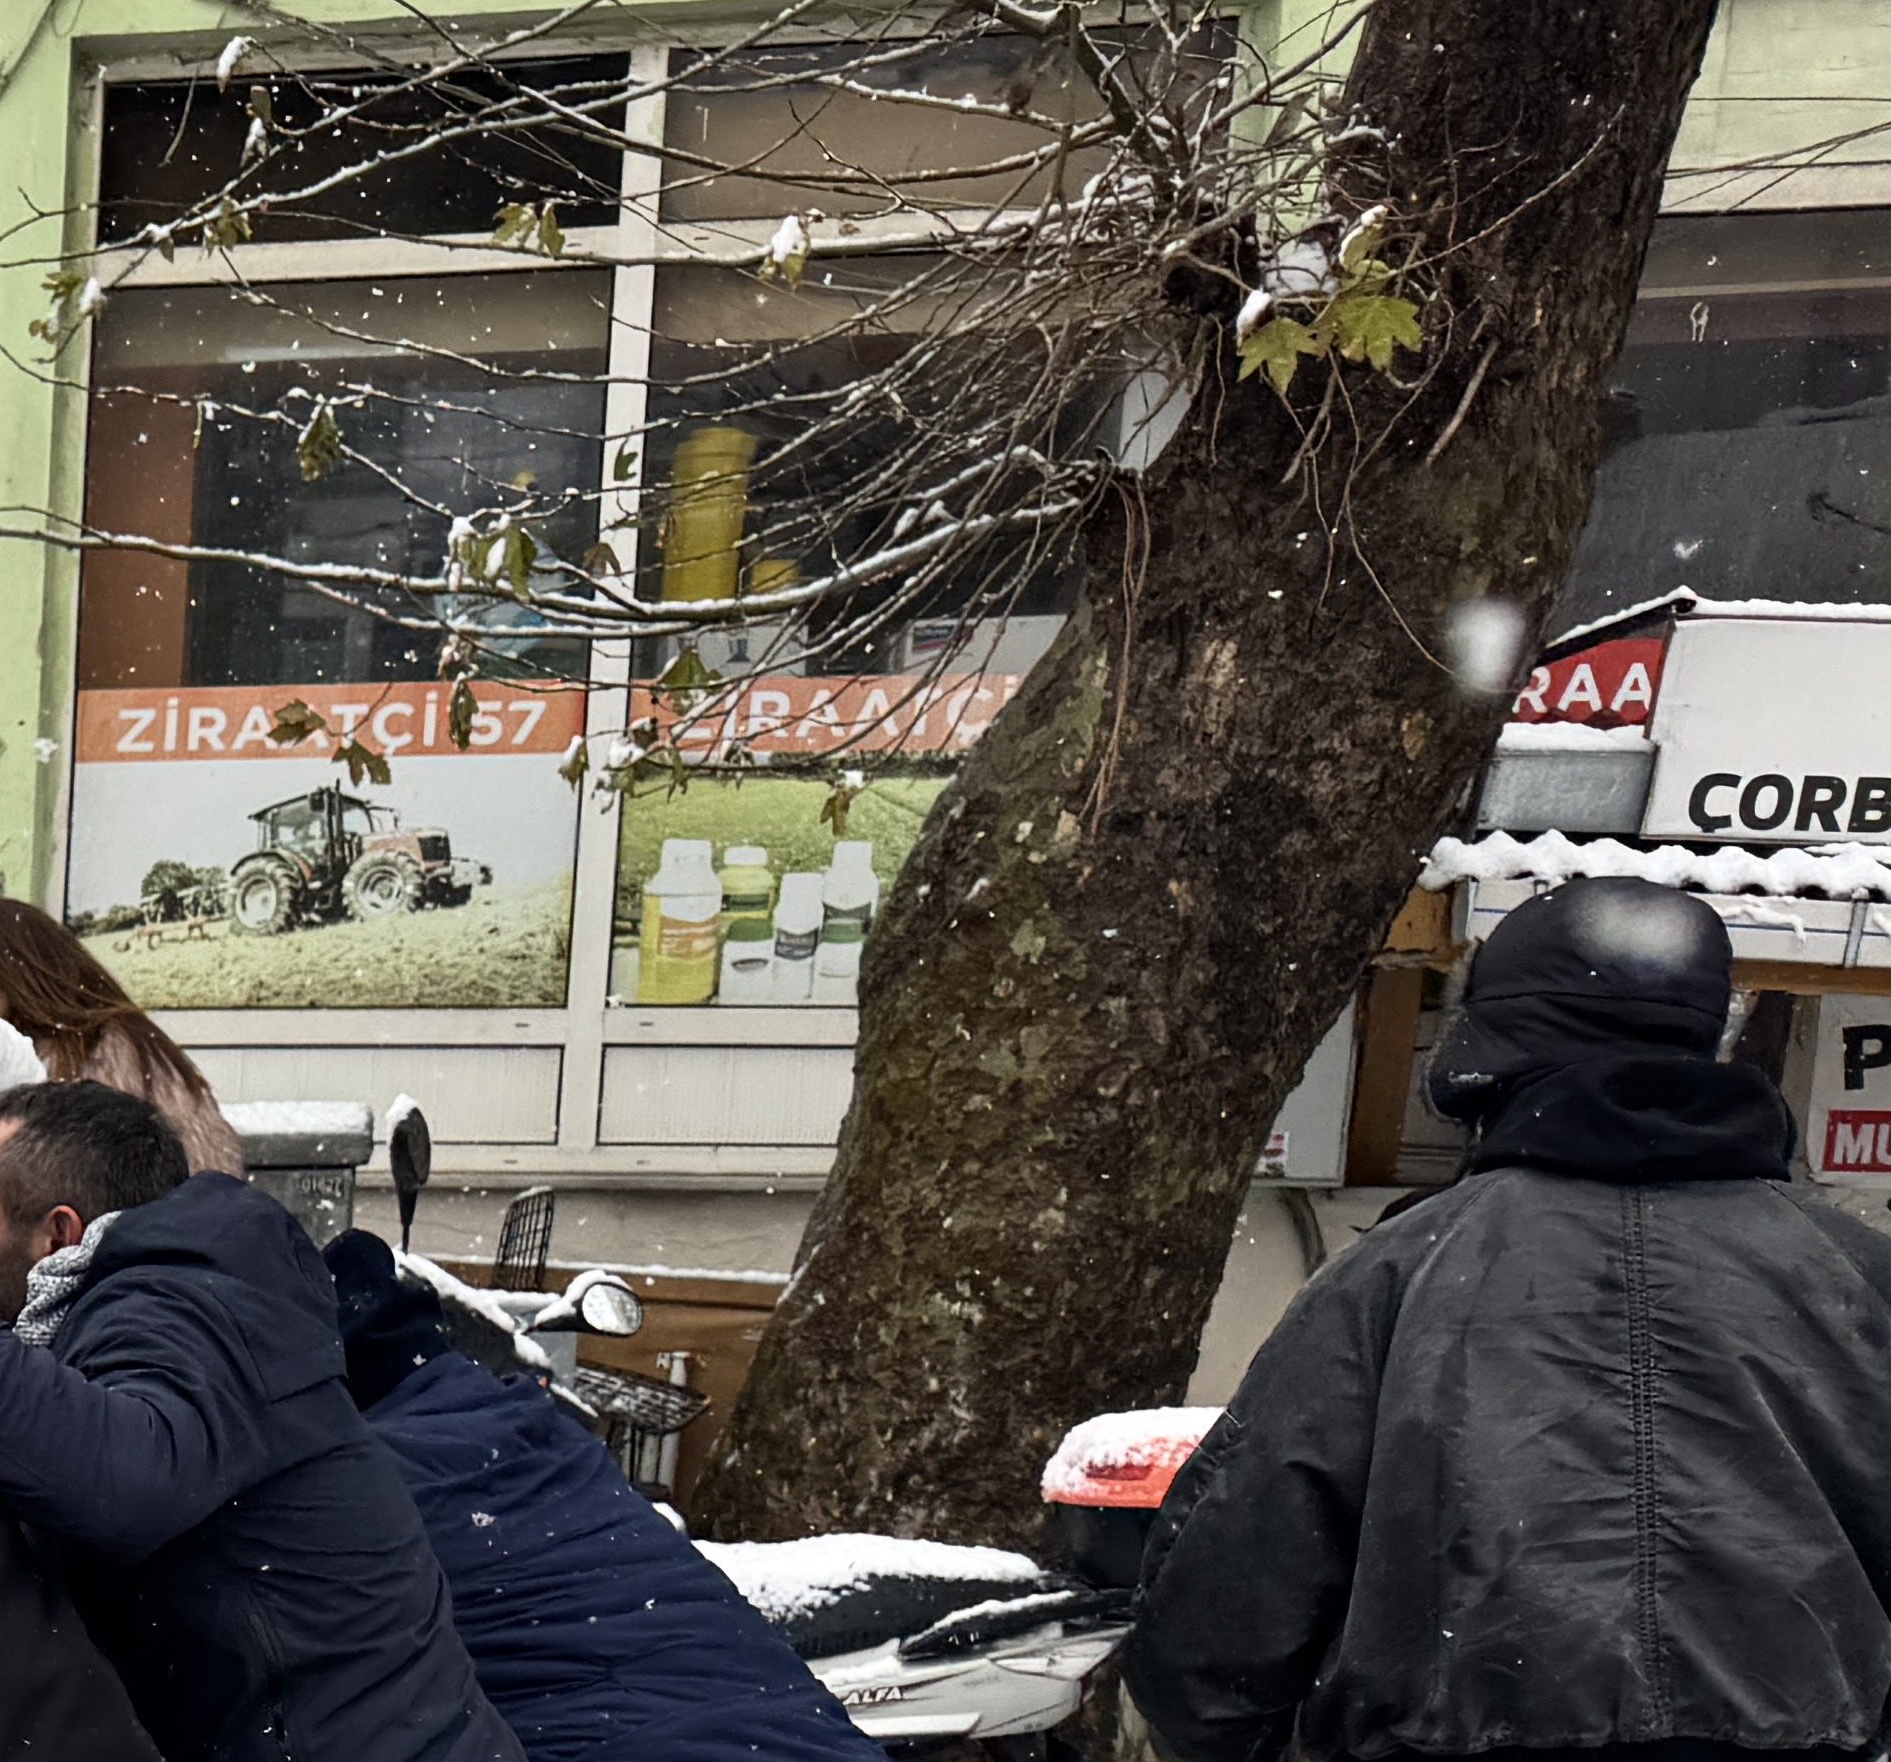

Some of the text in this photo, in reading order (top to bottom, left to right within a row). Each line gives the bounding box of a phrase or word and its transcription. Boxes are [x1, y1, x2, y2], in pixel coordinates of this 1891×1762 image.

[469, 700, 547, 747] 57
[1688, 772, 1891, 833] ÇORB
[842, 1686, 902, 1706] ALFA
